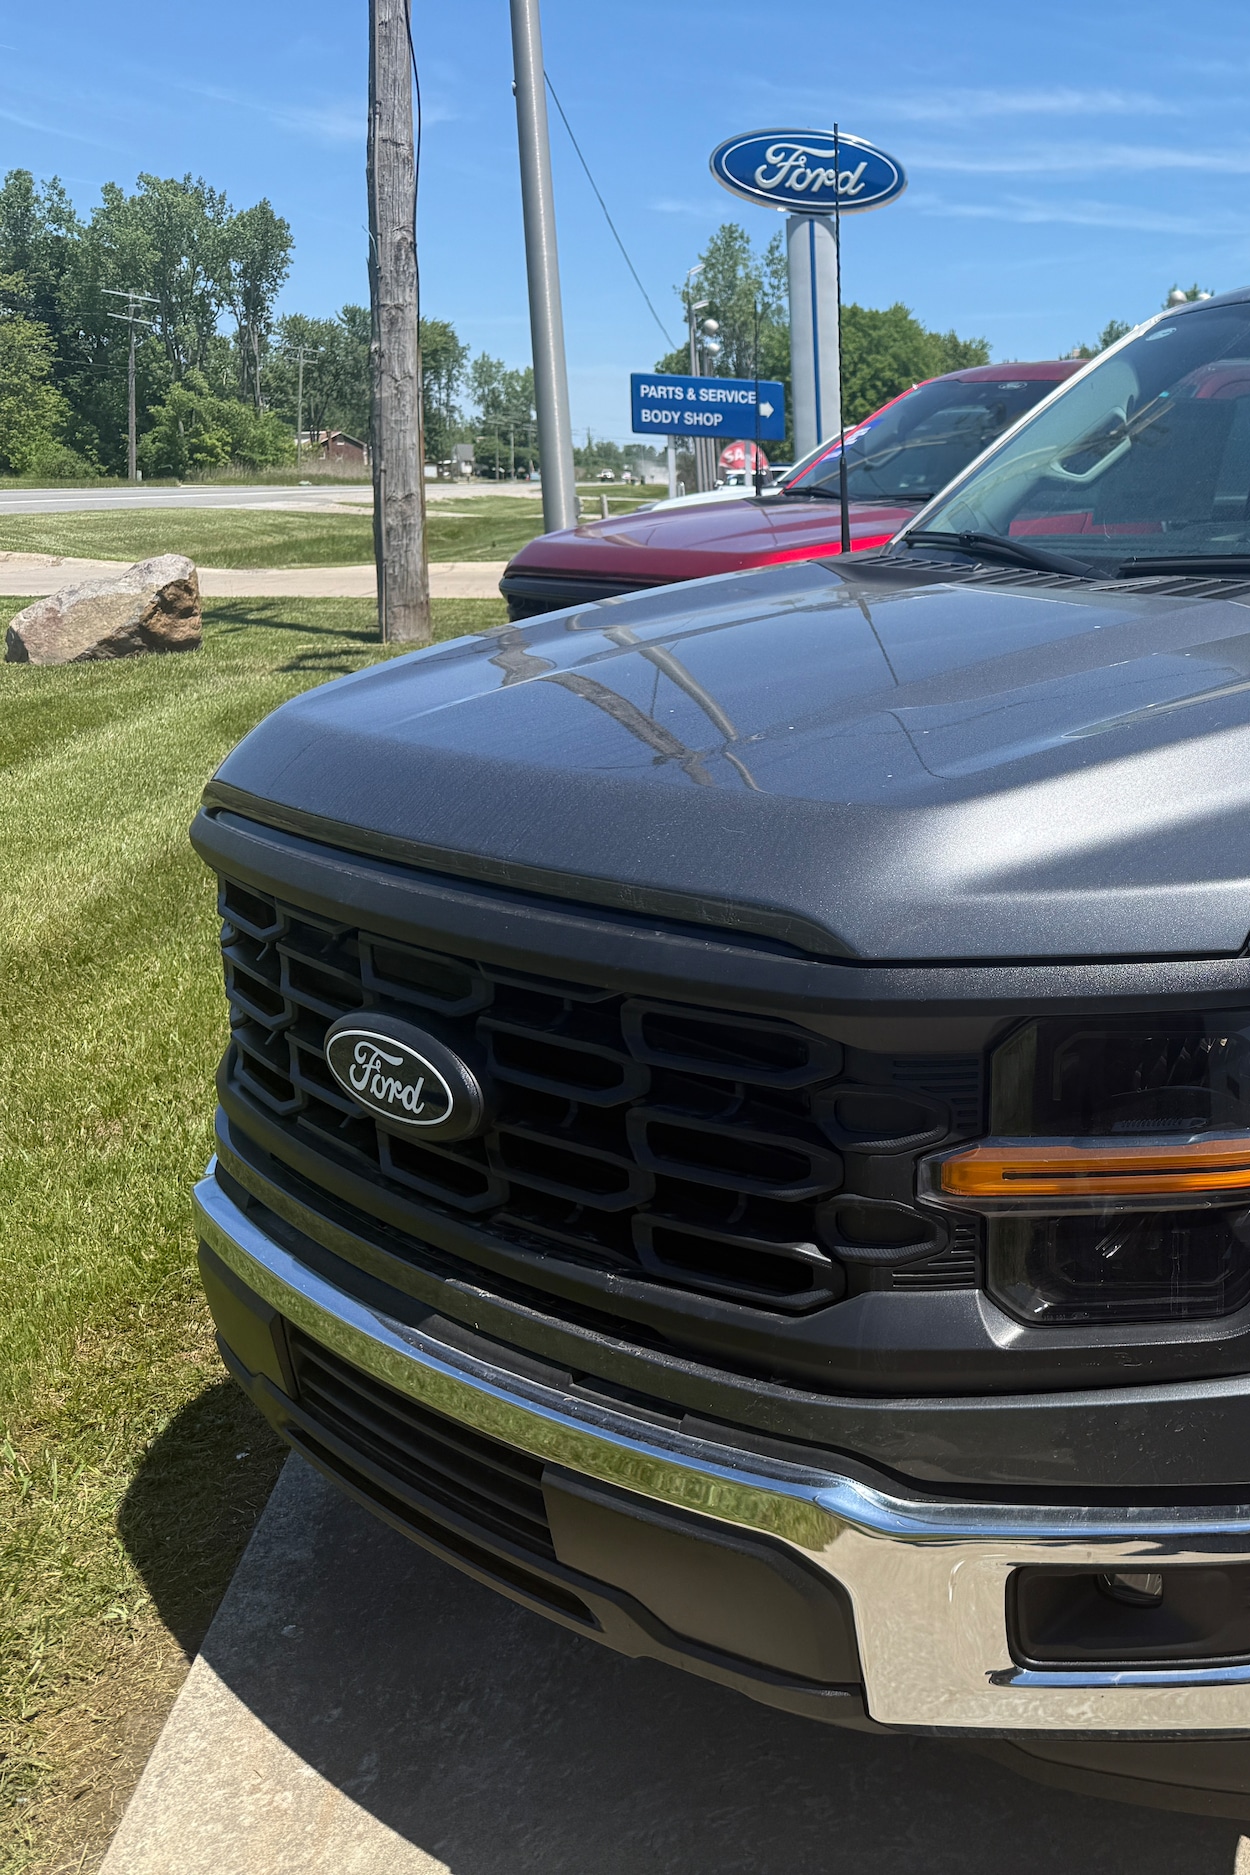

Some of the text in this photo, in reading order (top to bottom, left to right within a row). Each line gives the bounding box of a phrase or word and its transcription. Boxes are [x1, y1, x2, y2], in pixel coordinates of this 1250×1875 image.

[755, 143, 868, 195] Ford
[640, 384, 757, 405] PARTS & SERVICE
[641, 409, 724, 427] BODY SHOP
[349, 1041, 425, 1114] Ford
